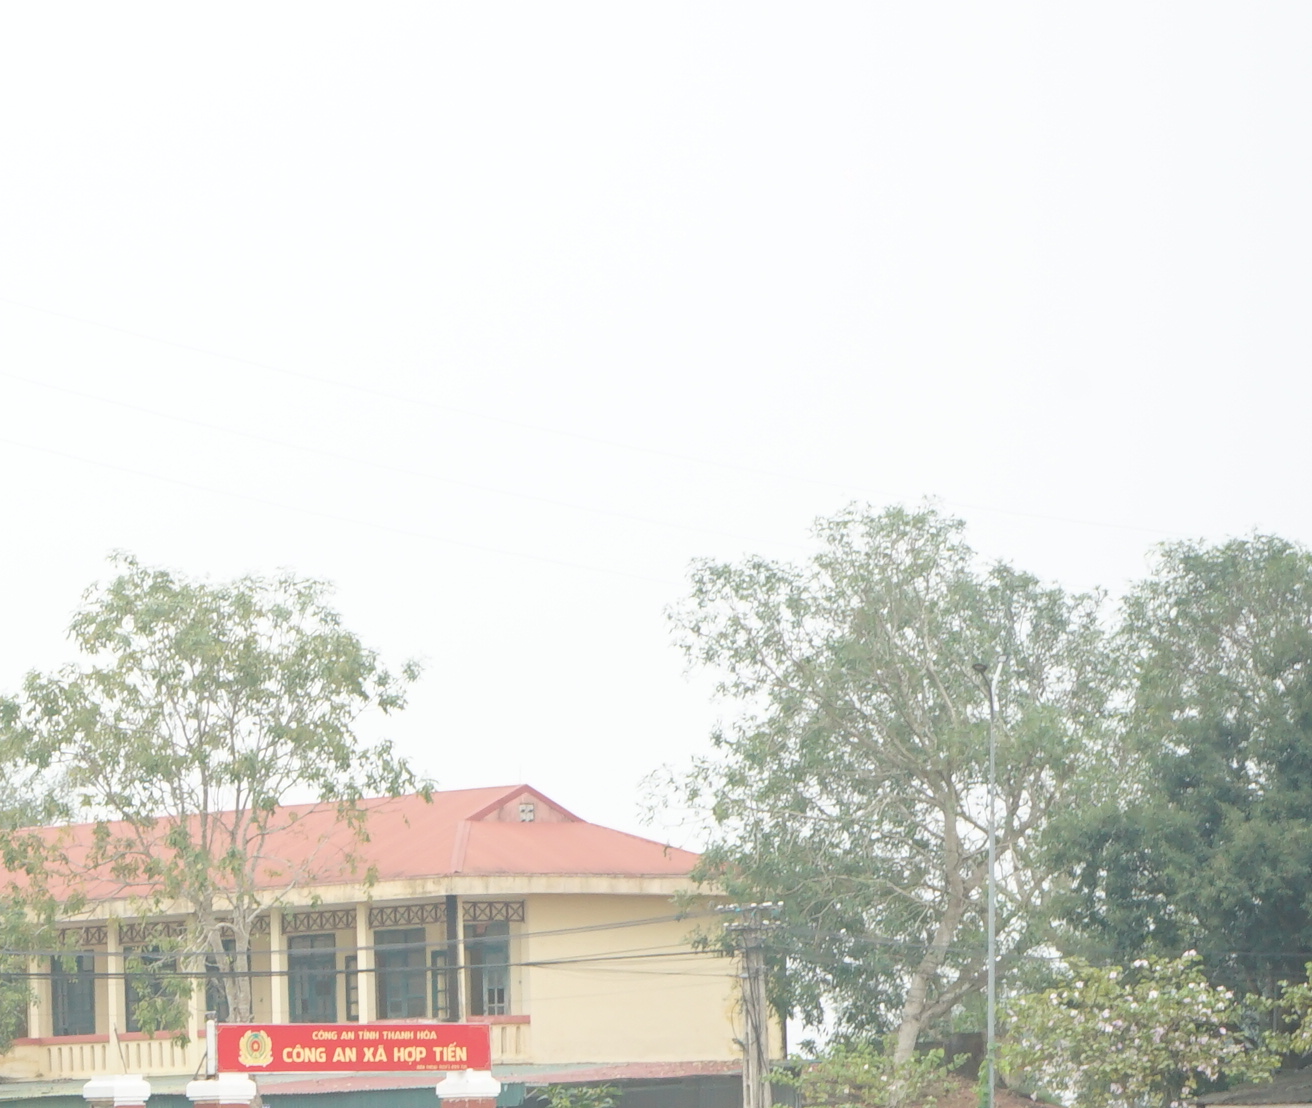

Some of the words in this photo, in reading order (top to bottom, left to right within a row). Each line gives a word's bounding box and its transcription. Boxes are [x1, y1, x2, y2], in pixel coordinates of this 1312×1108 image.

[312, 1029, 337, 1040] CÔNG
[340, 1031, 355, 1040] AN
[358, 1029, 380, 1040] TỈNH
[382, 1031, 414, 1040] THANH
[417, 1029, 437, 1040] HÓA
[282, 1045, 326, 1063] CÔNG
[332, 1047, 356, 1062] AN
[363, 1044, 387, 1062] XÃ
[394, 1045, 427, 1065] HỢP
[433, 1042, 467, 1062] TIẾN
